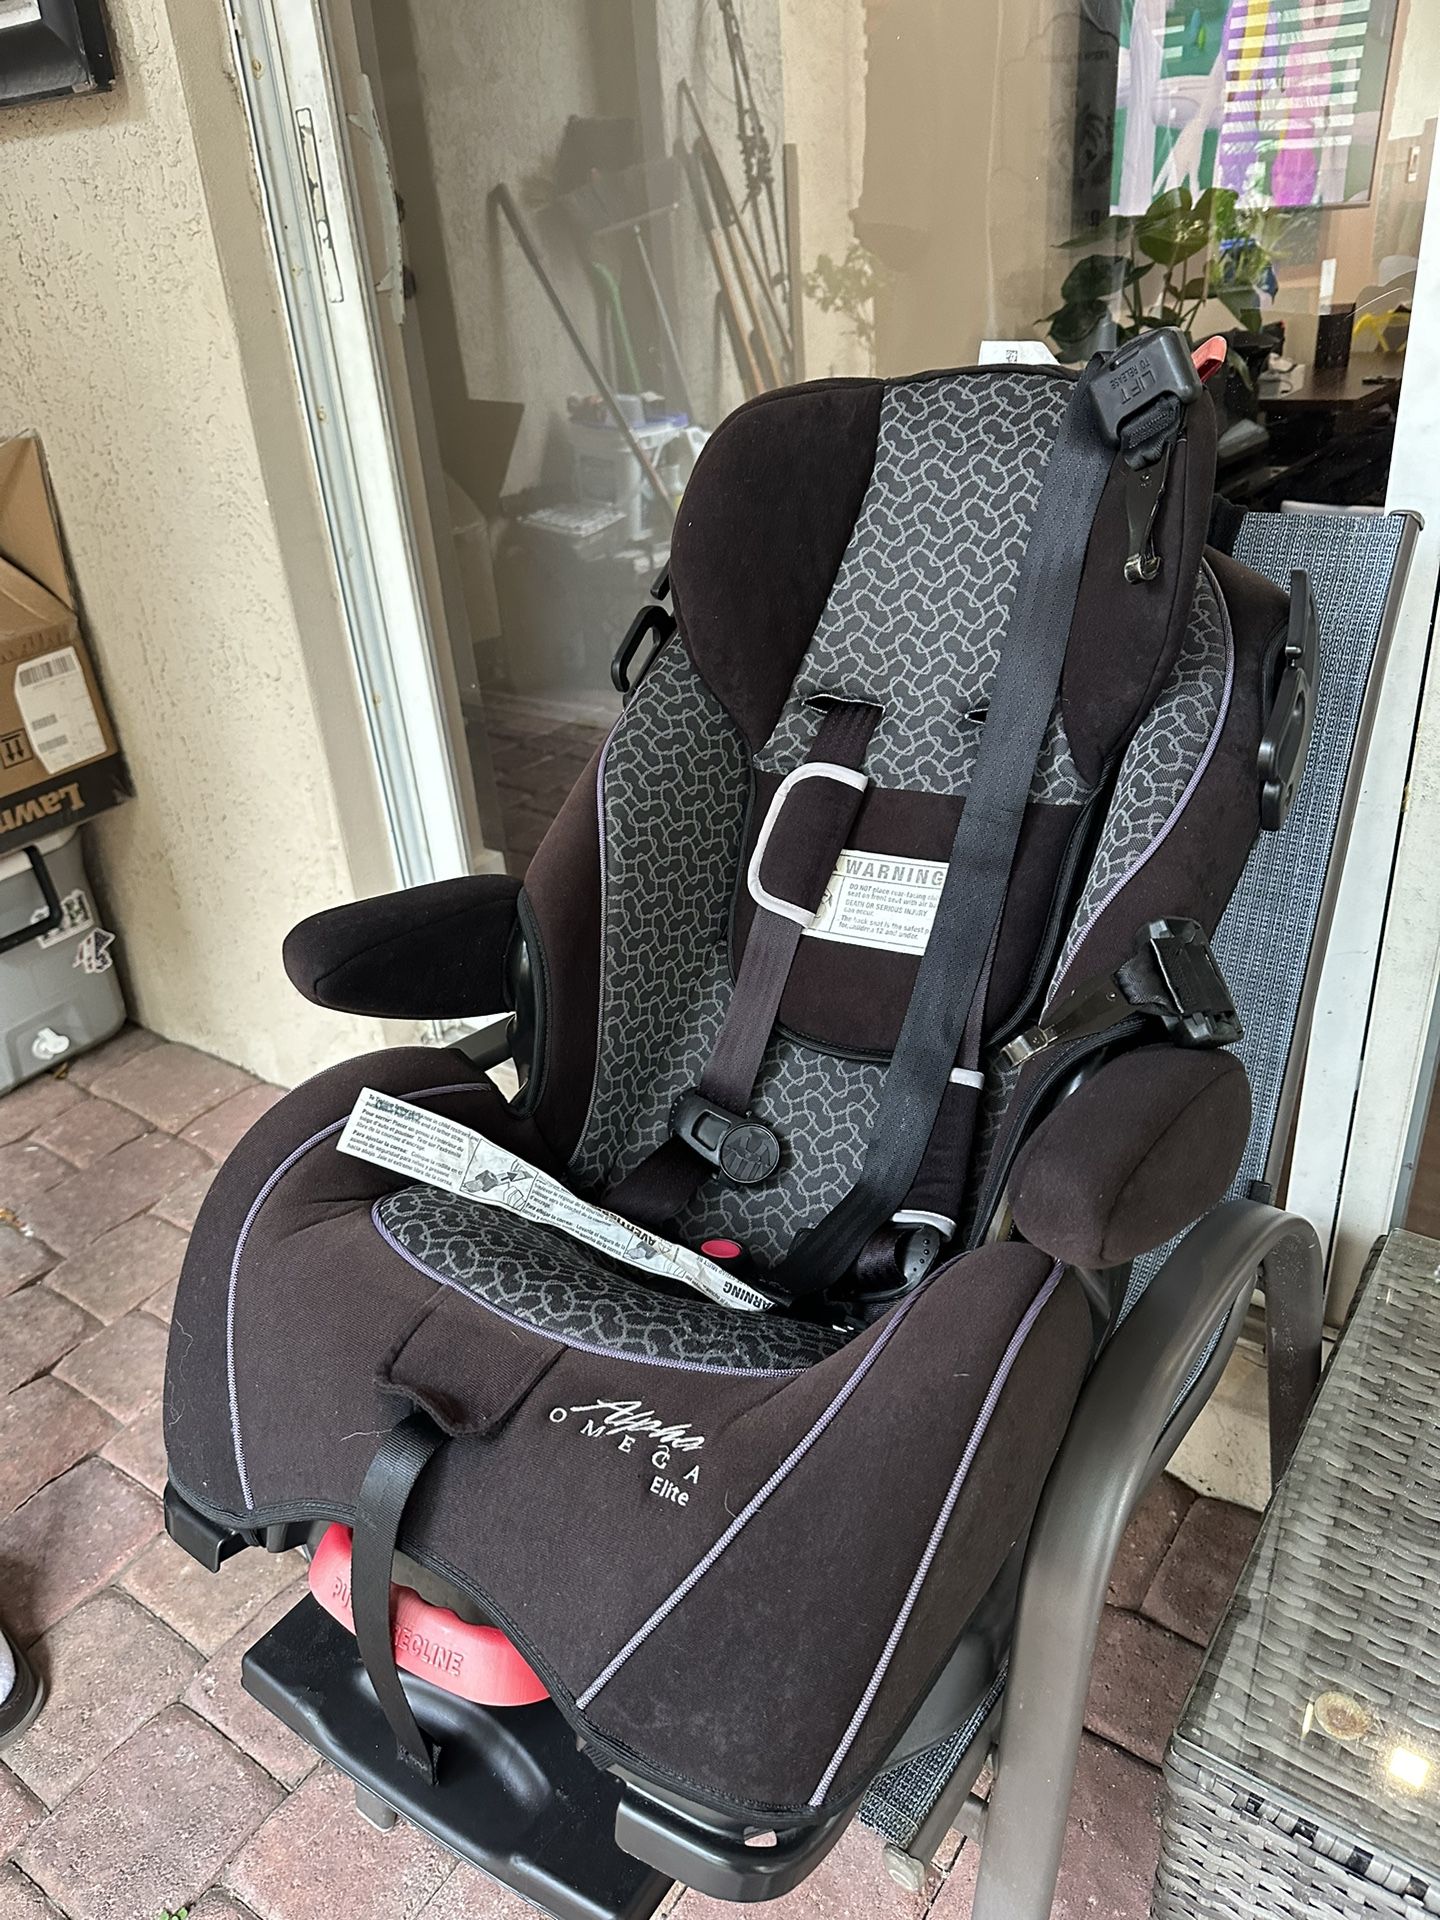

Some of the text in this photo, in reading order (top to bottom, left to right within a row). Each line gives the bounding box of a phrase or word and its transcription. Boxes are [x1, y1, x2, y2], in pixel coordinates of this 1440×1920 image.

[1110, 357, 1150, 390] TO RELEASE
[1121, 369, 1156, 405] LIFT
[0, 783, 85, 833] Lawn
[846, 859, 944, 886] WARNING
[849, 882, 859, 890] DO
[860, 884, 872, 892] NOT
[845, 898, 928, 917] DEATH OR SERIOUS INJURY
[904, 924, 924, 933] safest
[723, 1281, 771, 1310] ARNING
[550, 1407, 700, 1484] OMEGA
[650, 1476, 690, 1506] Elite
